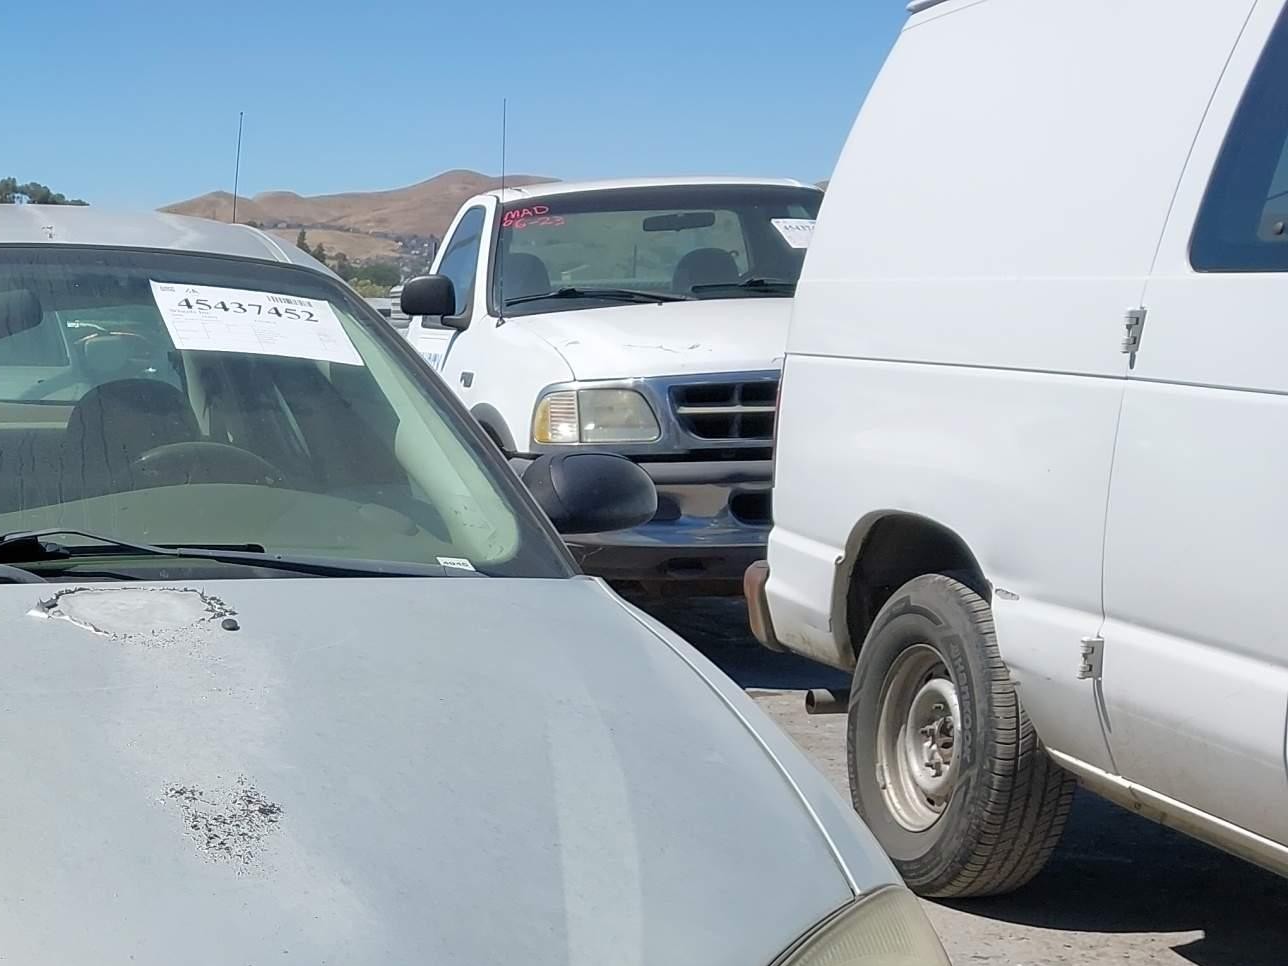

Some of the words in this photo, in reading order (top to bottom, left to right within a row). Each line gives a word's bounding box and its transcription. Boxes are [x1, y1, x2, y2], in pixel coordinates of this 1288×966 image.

[503, 205, 549, 221] MAD
[502, 215, 566, 229] 06-23
[177, 297, 320, 324] 45437452
